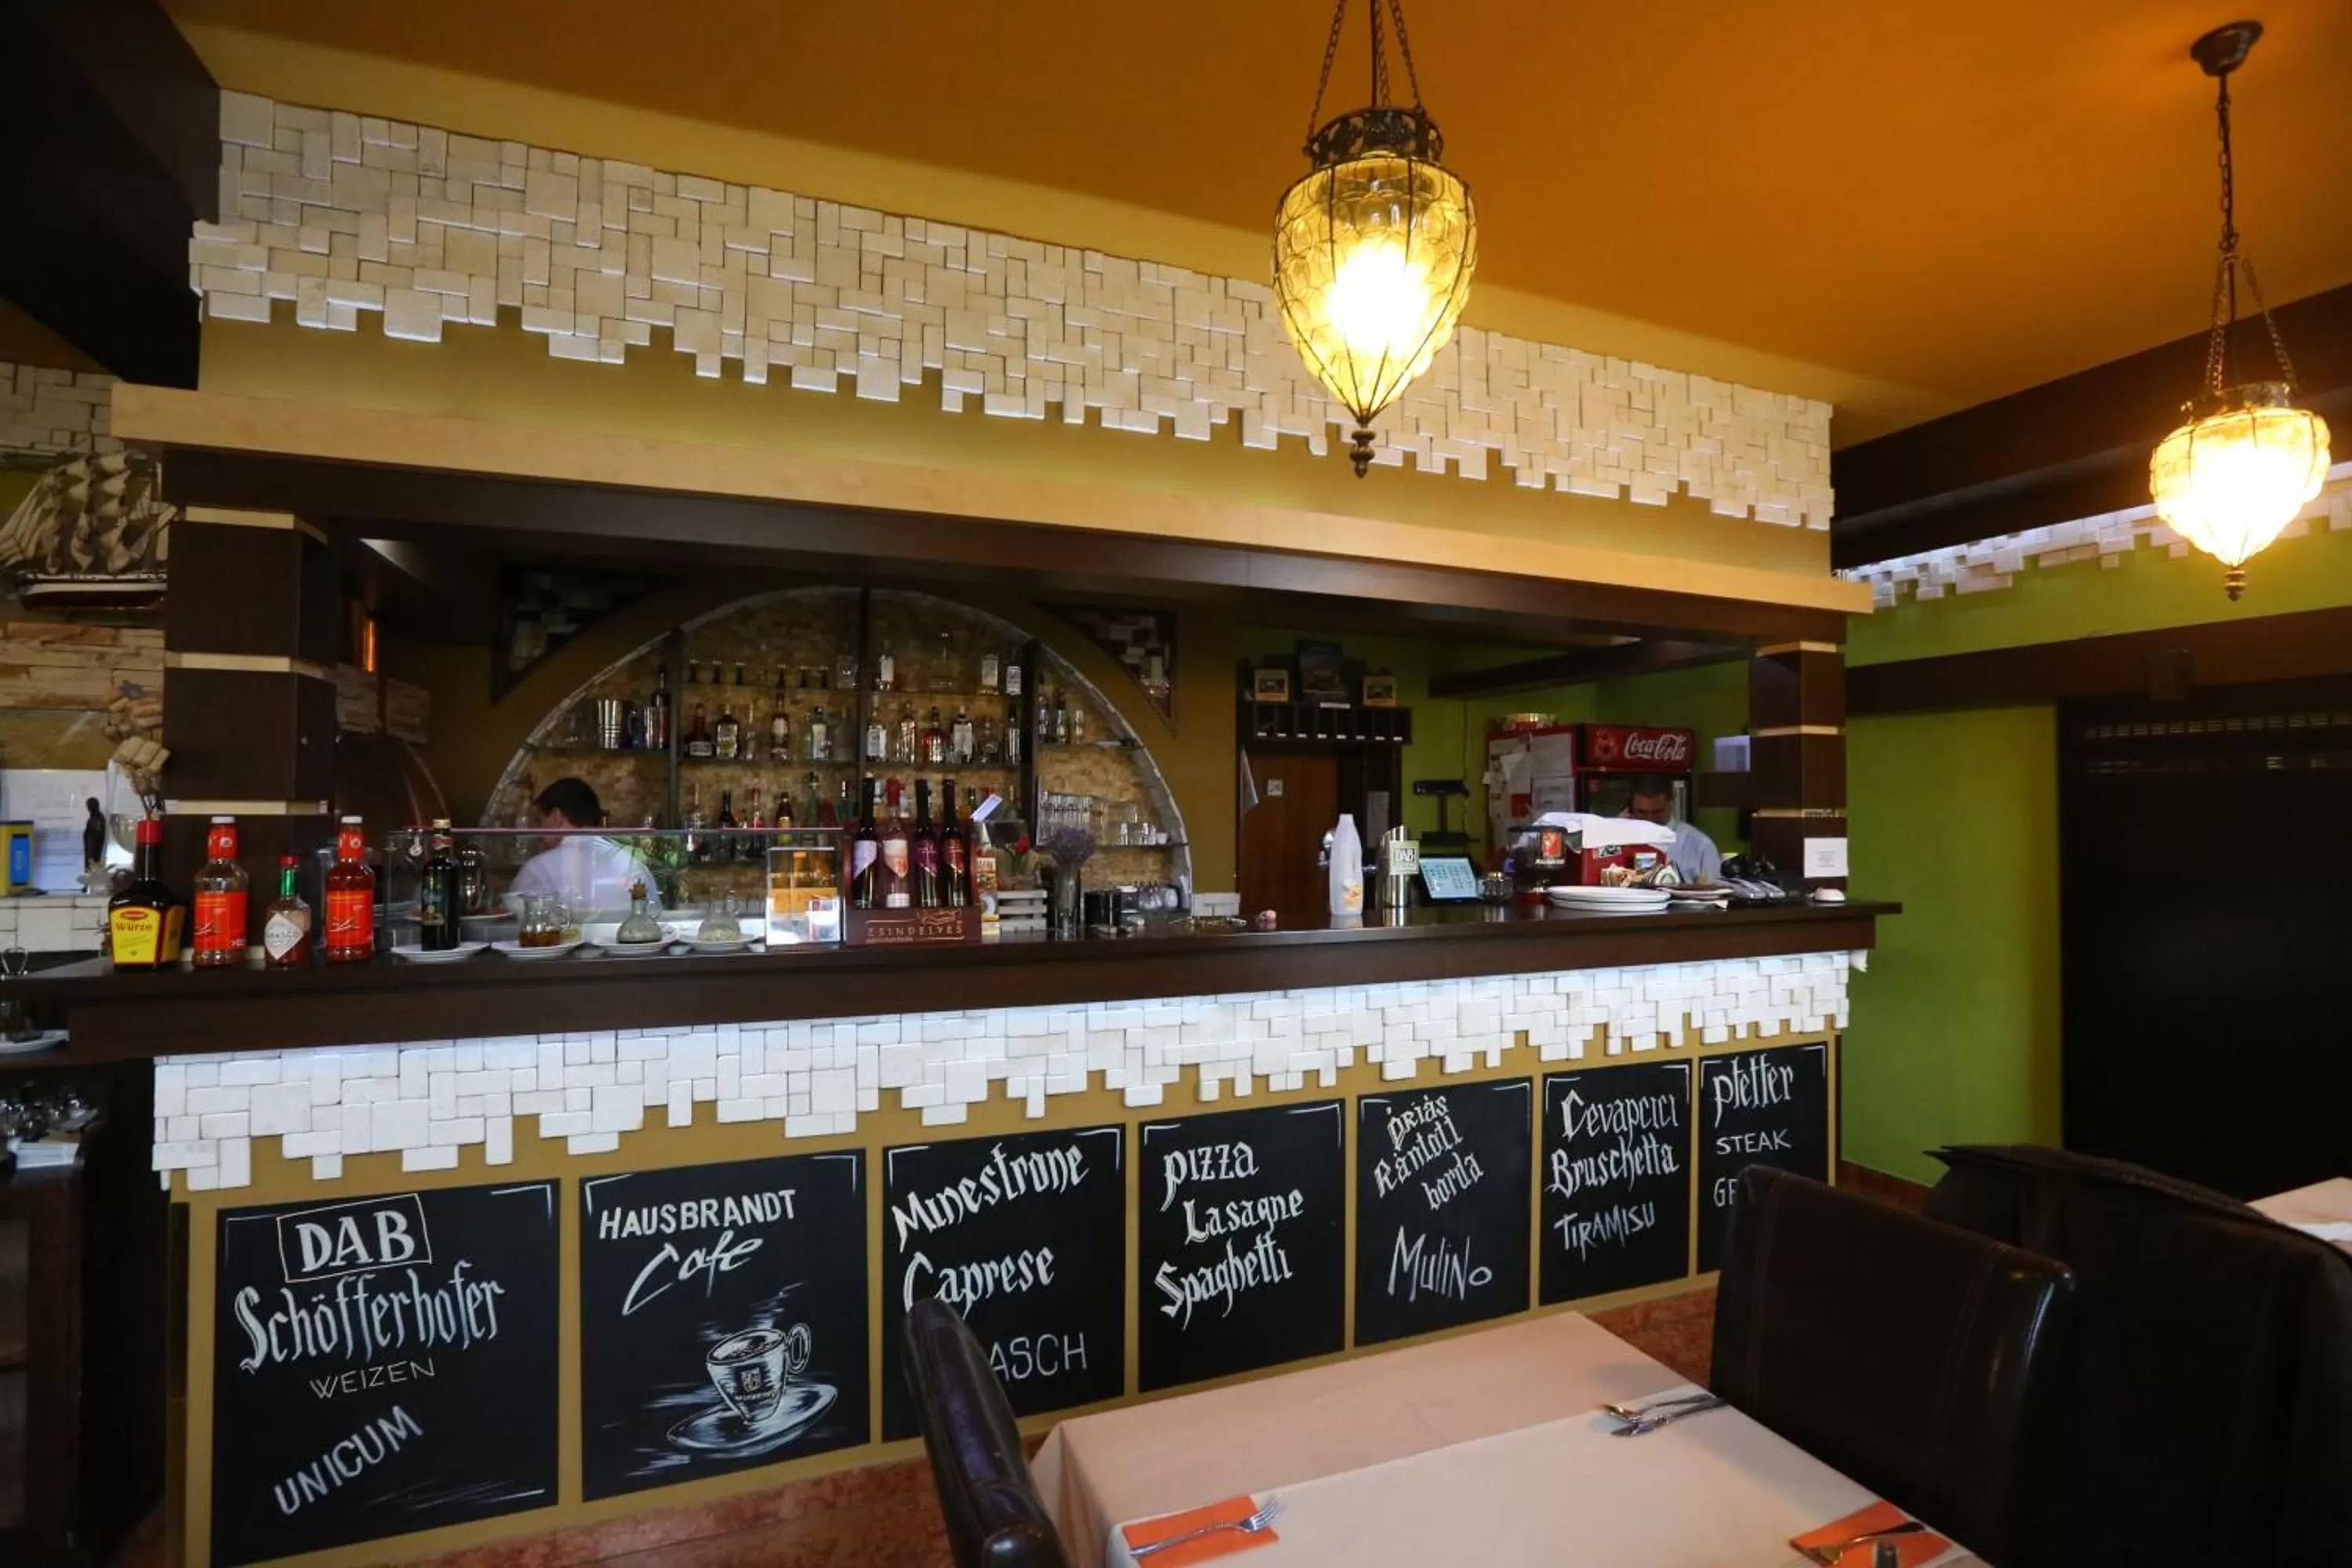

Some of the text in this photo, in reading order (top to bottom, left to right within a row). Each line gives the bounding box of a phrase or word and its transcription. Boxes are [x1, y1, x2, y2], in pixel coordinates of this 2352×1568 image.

[1624, 731, 1686, 760] Coca-Cola
[1544, 1132, 1680, 1199] Bruschetta
[1715, 1129, 1792, 1155] STEAK
[891, 1142, 1089, 1253] Minestrone
[1421, 1152, 1484, 1210] borda
[296, 1210, 416, 1272] DAB
[599, 1189, 796, 1240] HAUSBRANDT
[1182, 1189, 1304, 1245] Lasagne
[622, 1230, 764, 1316] Cafe
[903, 1247, 1054, 1321] Caprese
[1154, 1231, 1292, 1330] Spaghetti
[234, 1260, 506, 1375] Schöfferhofer
[310, 1357, 436, 1399] WEIZEN
[274, 1405, 423, 1515] UNICUM
